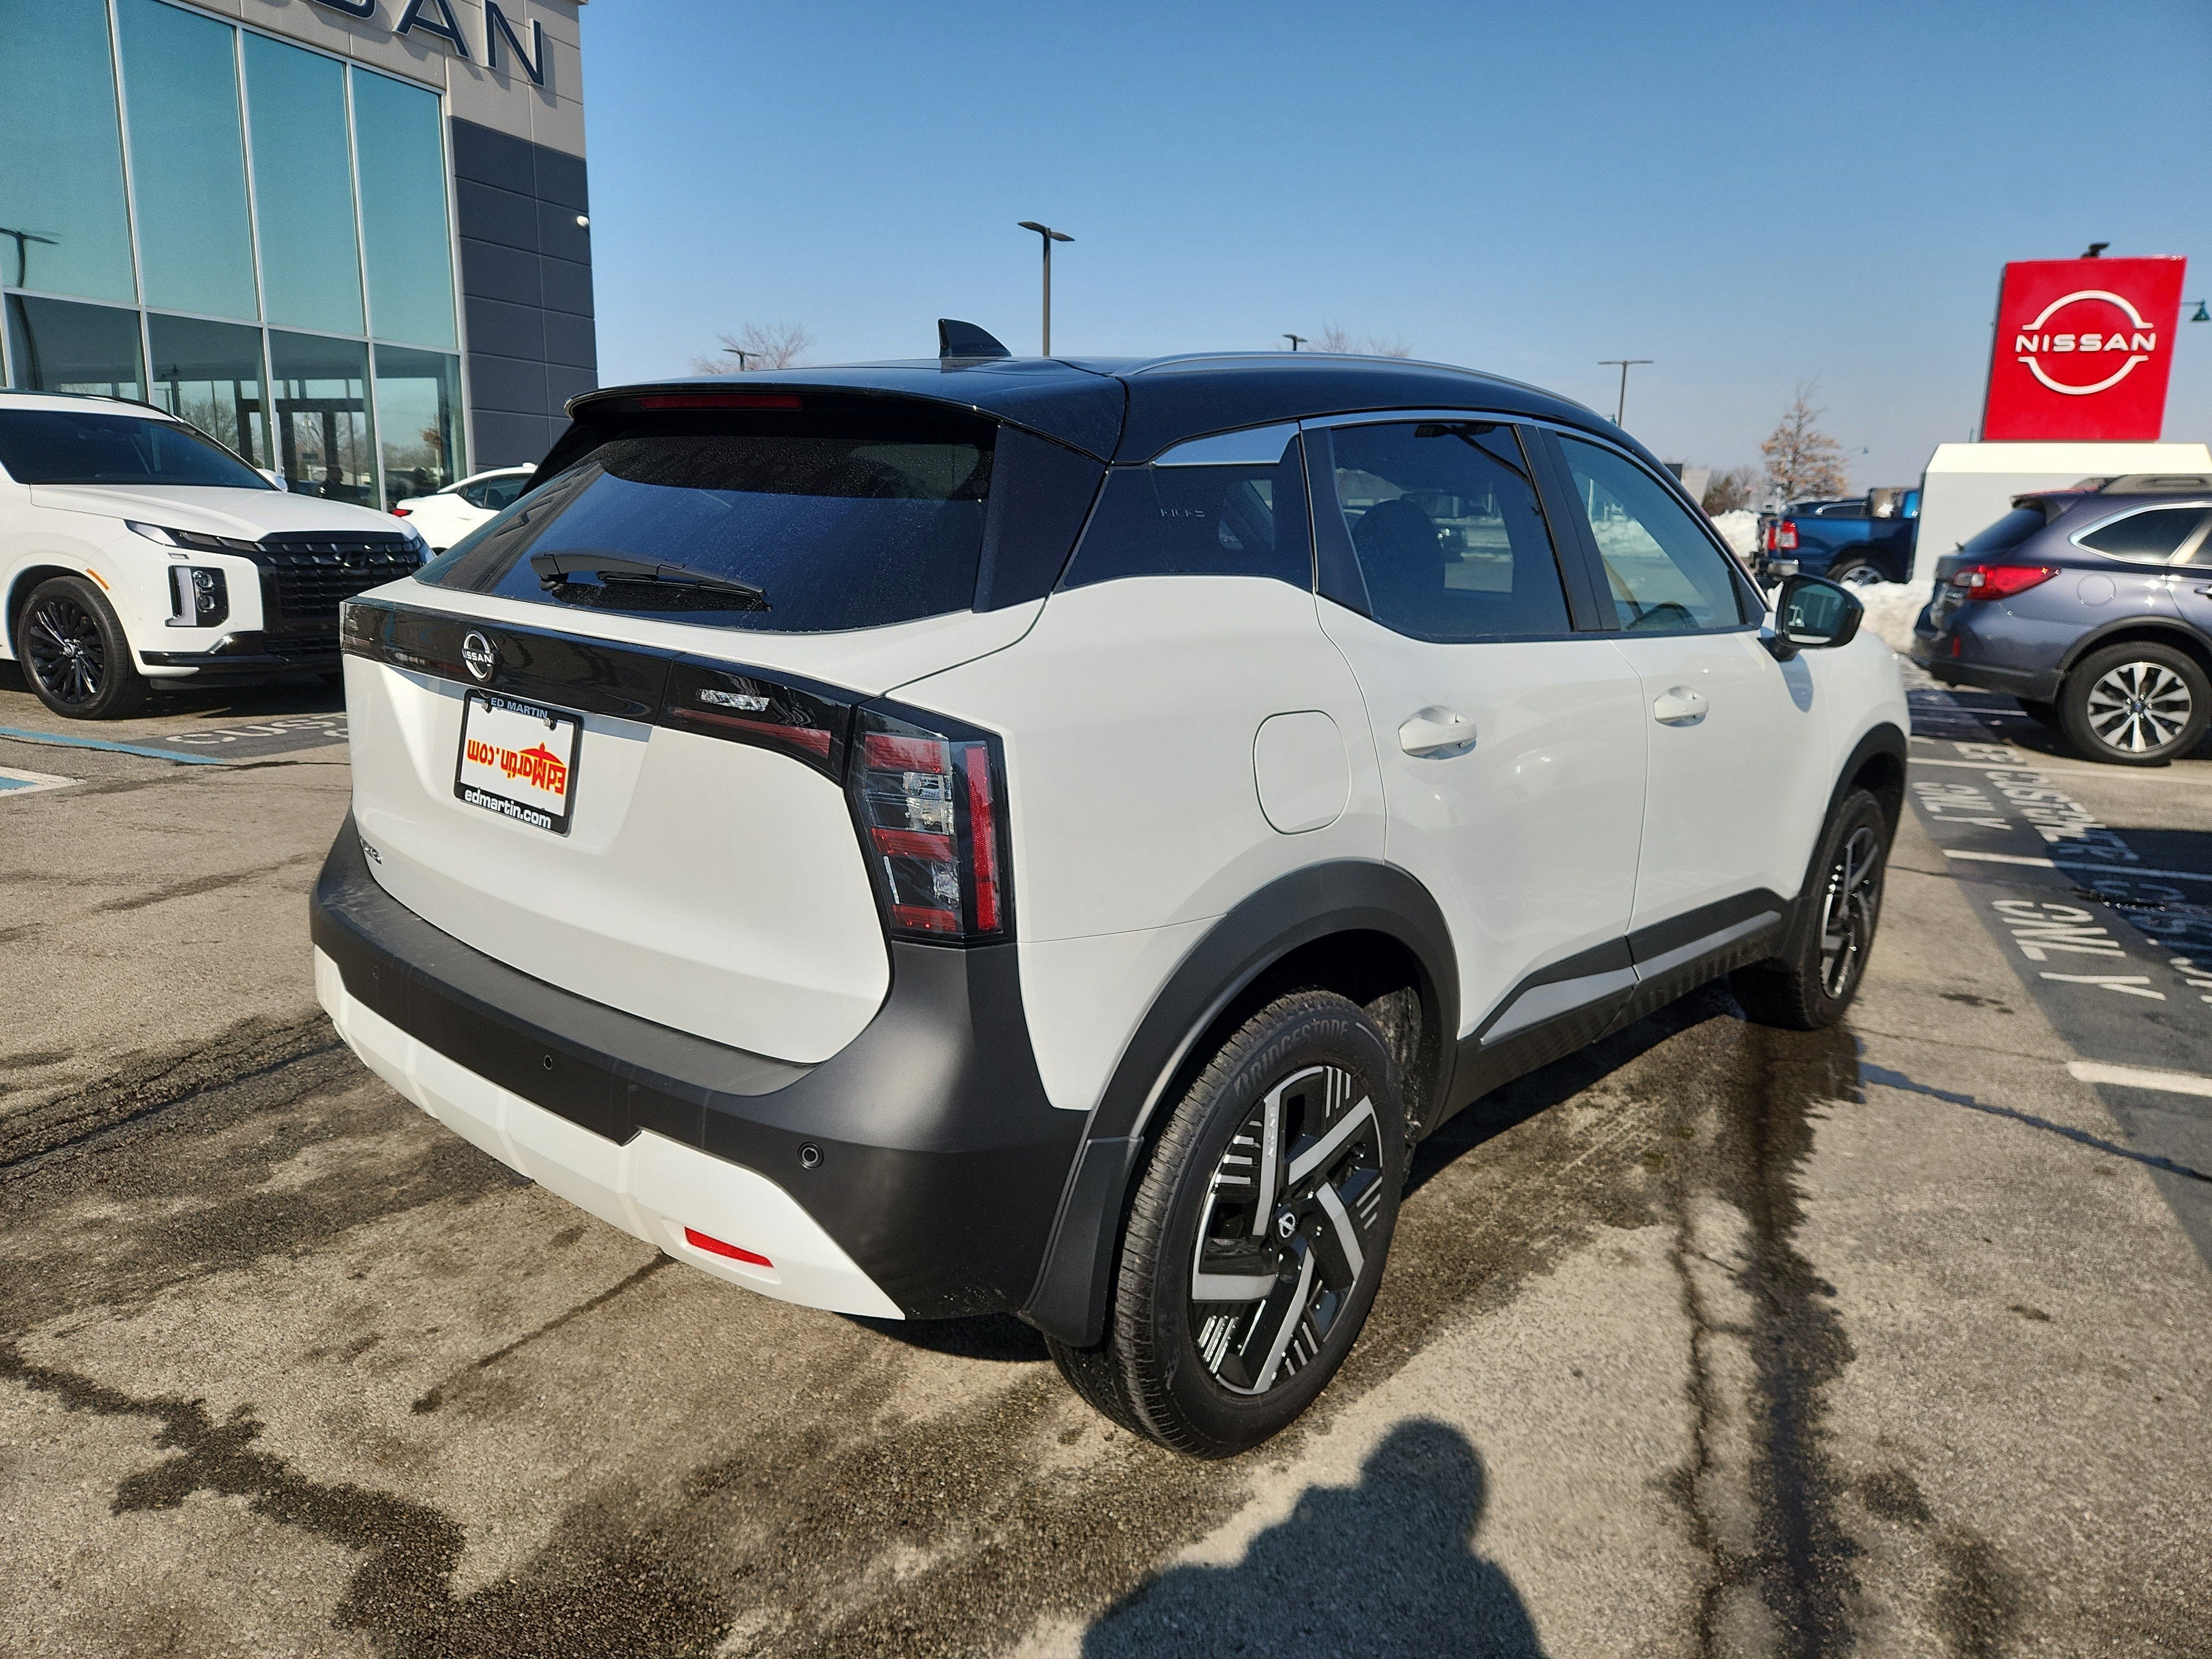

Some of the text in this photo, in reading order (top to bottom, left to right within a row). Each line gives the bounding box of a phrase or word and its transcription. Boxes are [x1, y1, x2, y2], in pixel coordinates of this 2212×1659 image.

[2015, 332, 2157, 353] NISSAN
[491, 697, 548, 719] ED MARTIN
[464, 789, 552, 829] edmartin.com
[1991, 899, 2167, 1002] ONLY
